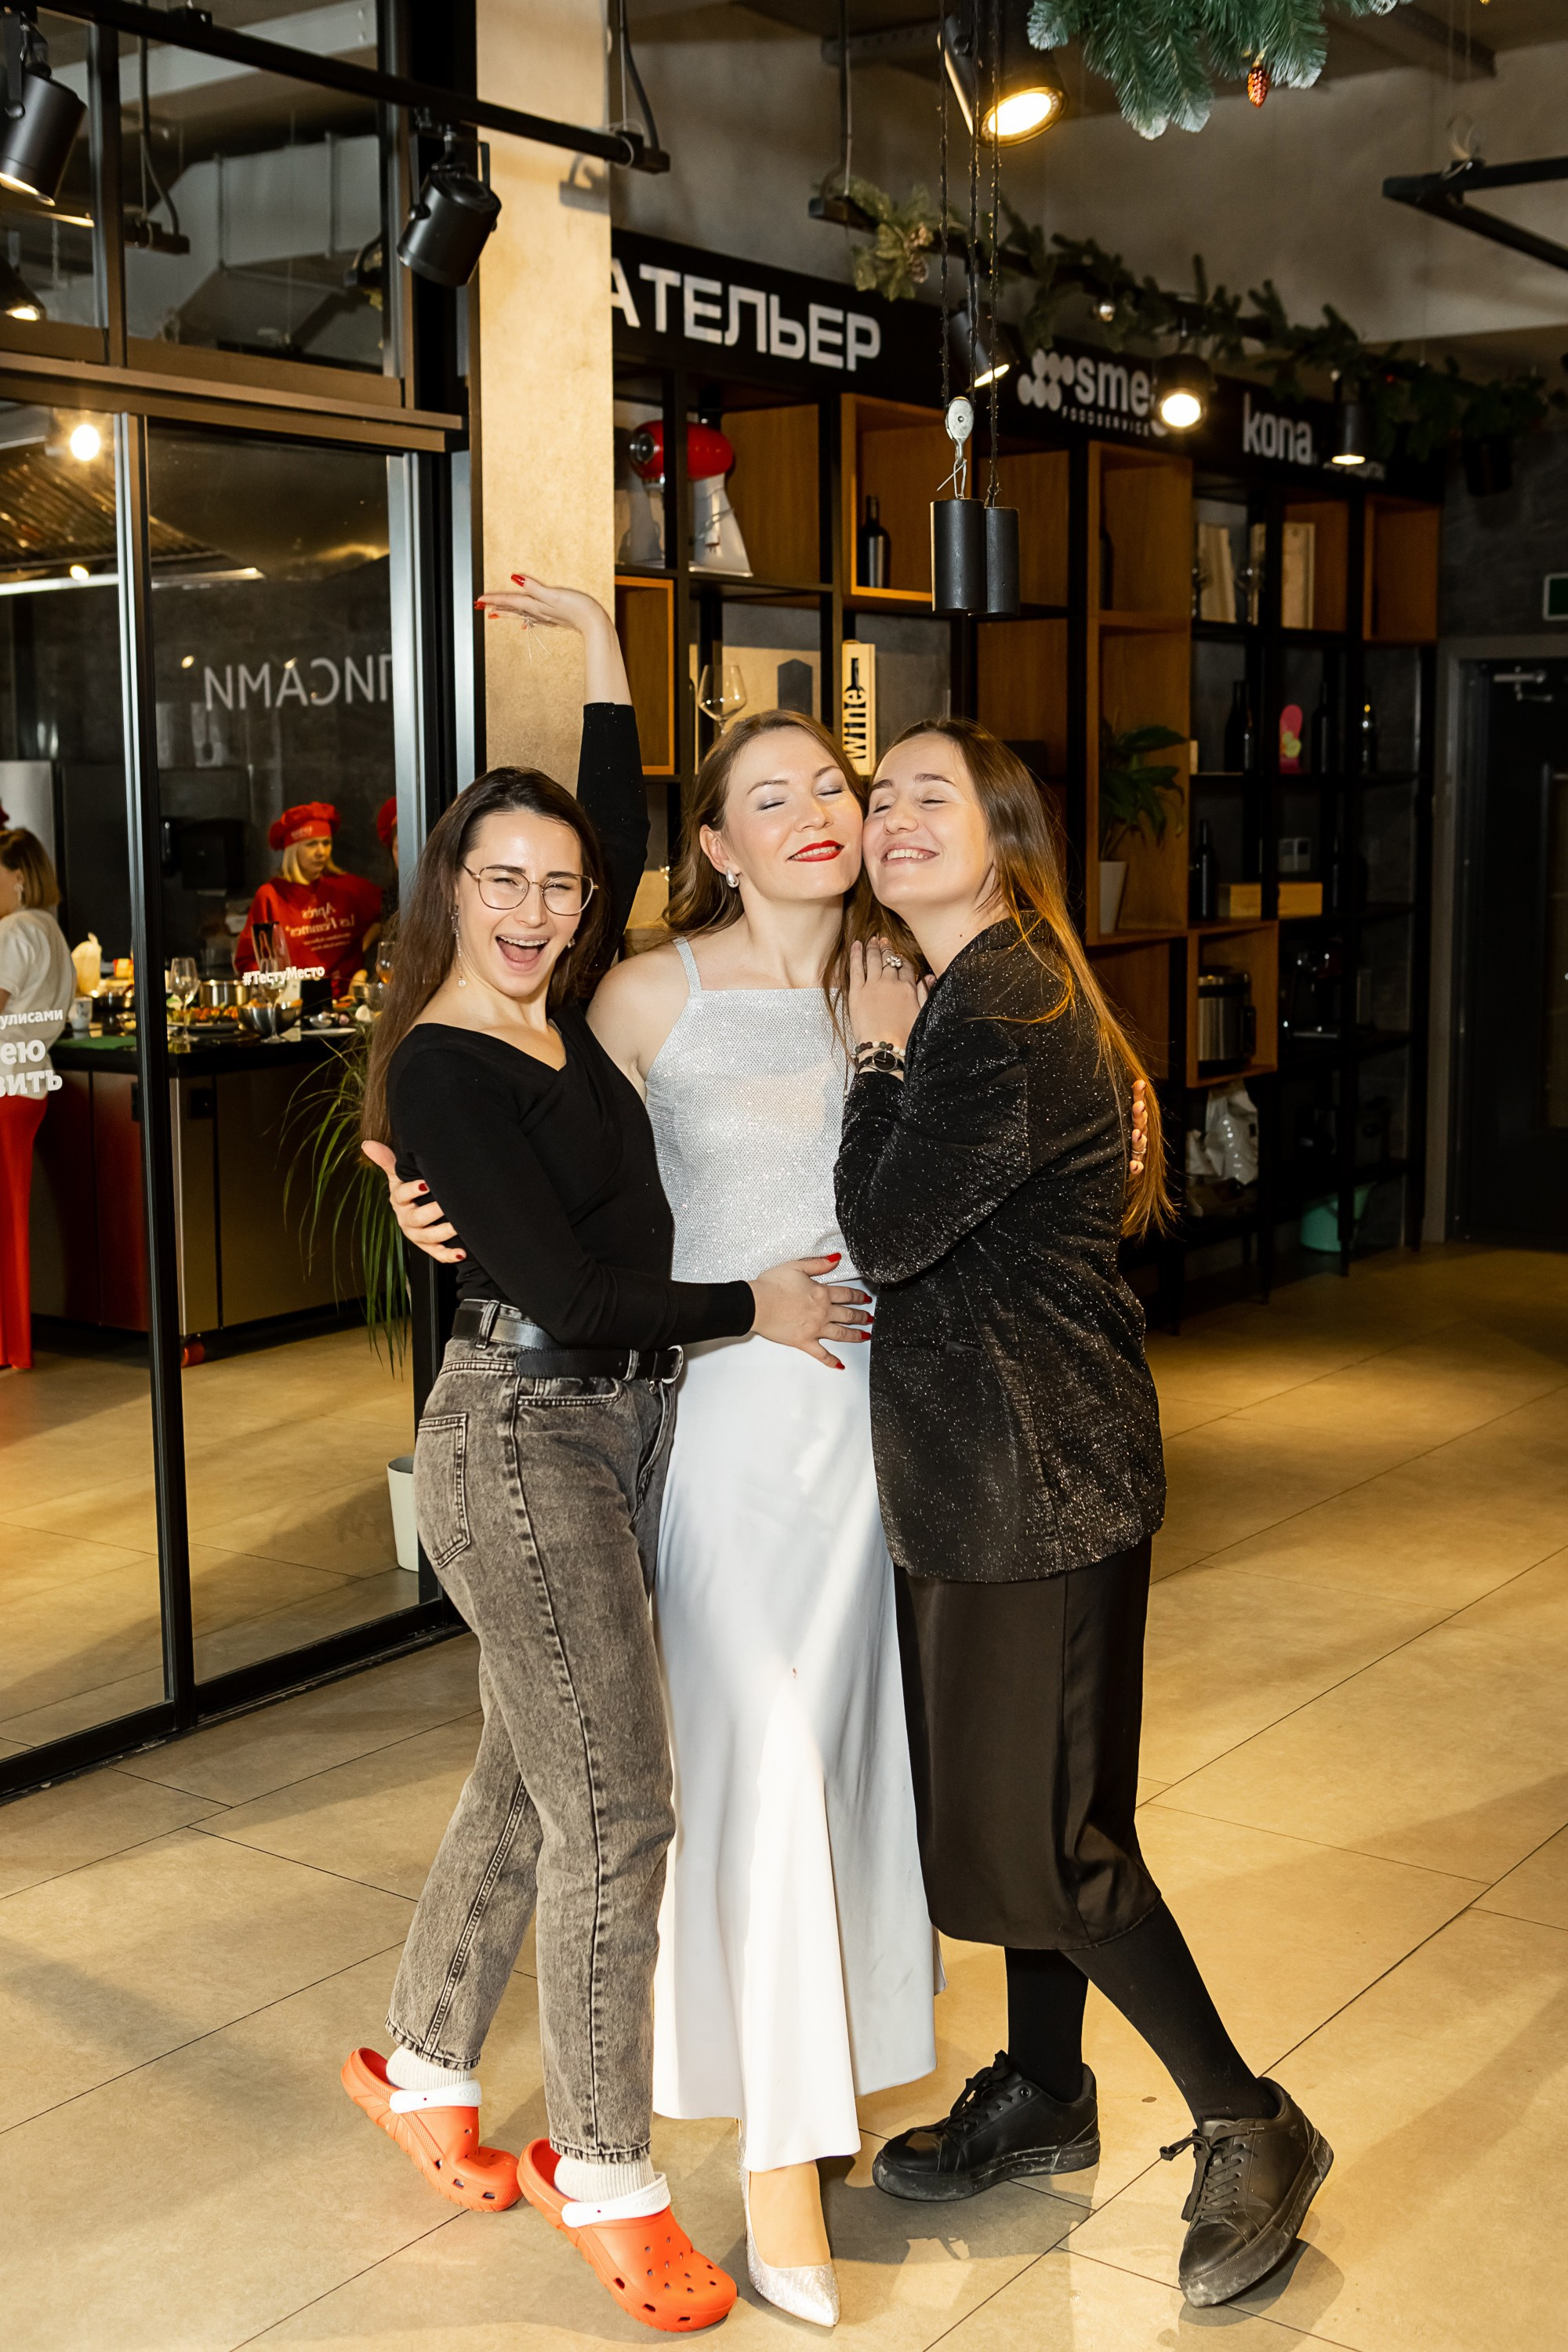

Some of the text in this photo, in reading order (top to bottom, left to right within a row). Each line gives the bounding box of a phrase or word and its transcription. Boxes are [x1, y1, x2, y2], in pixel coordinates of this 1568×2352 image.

[1243, 390, 1313, 463] kona
[843, 688, 867, 760] wine
[0, 1039, 46, 1065] ею
